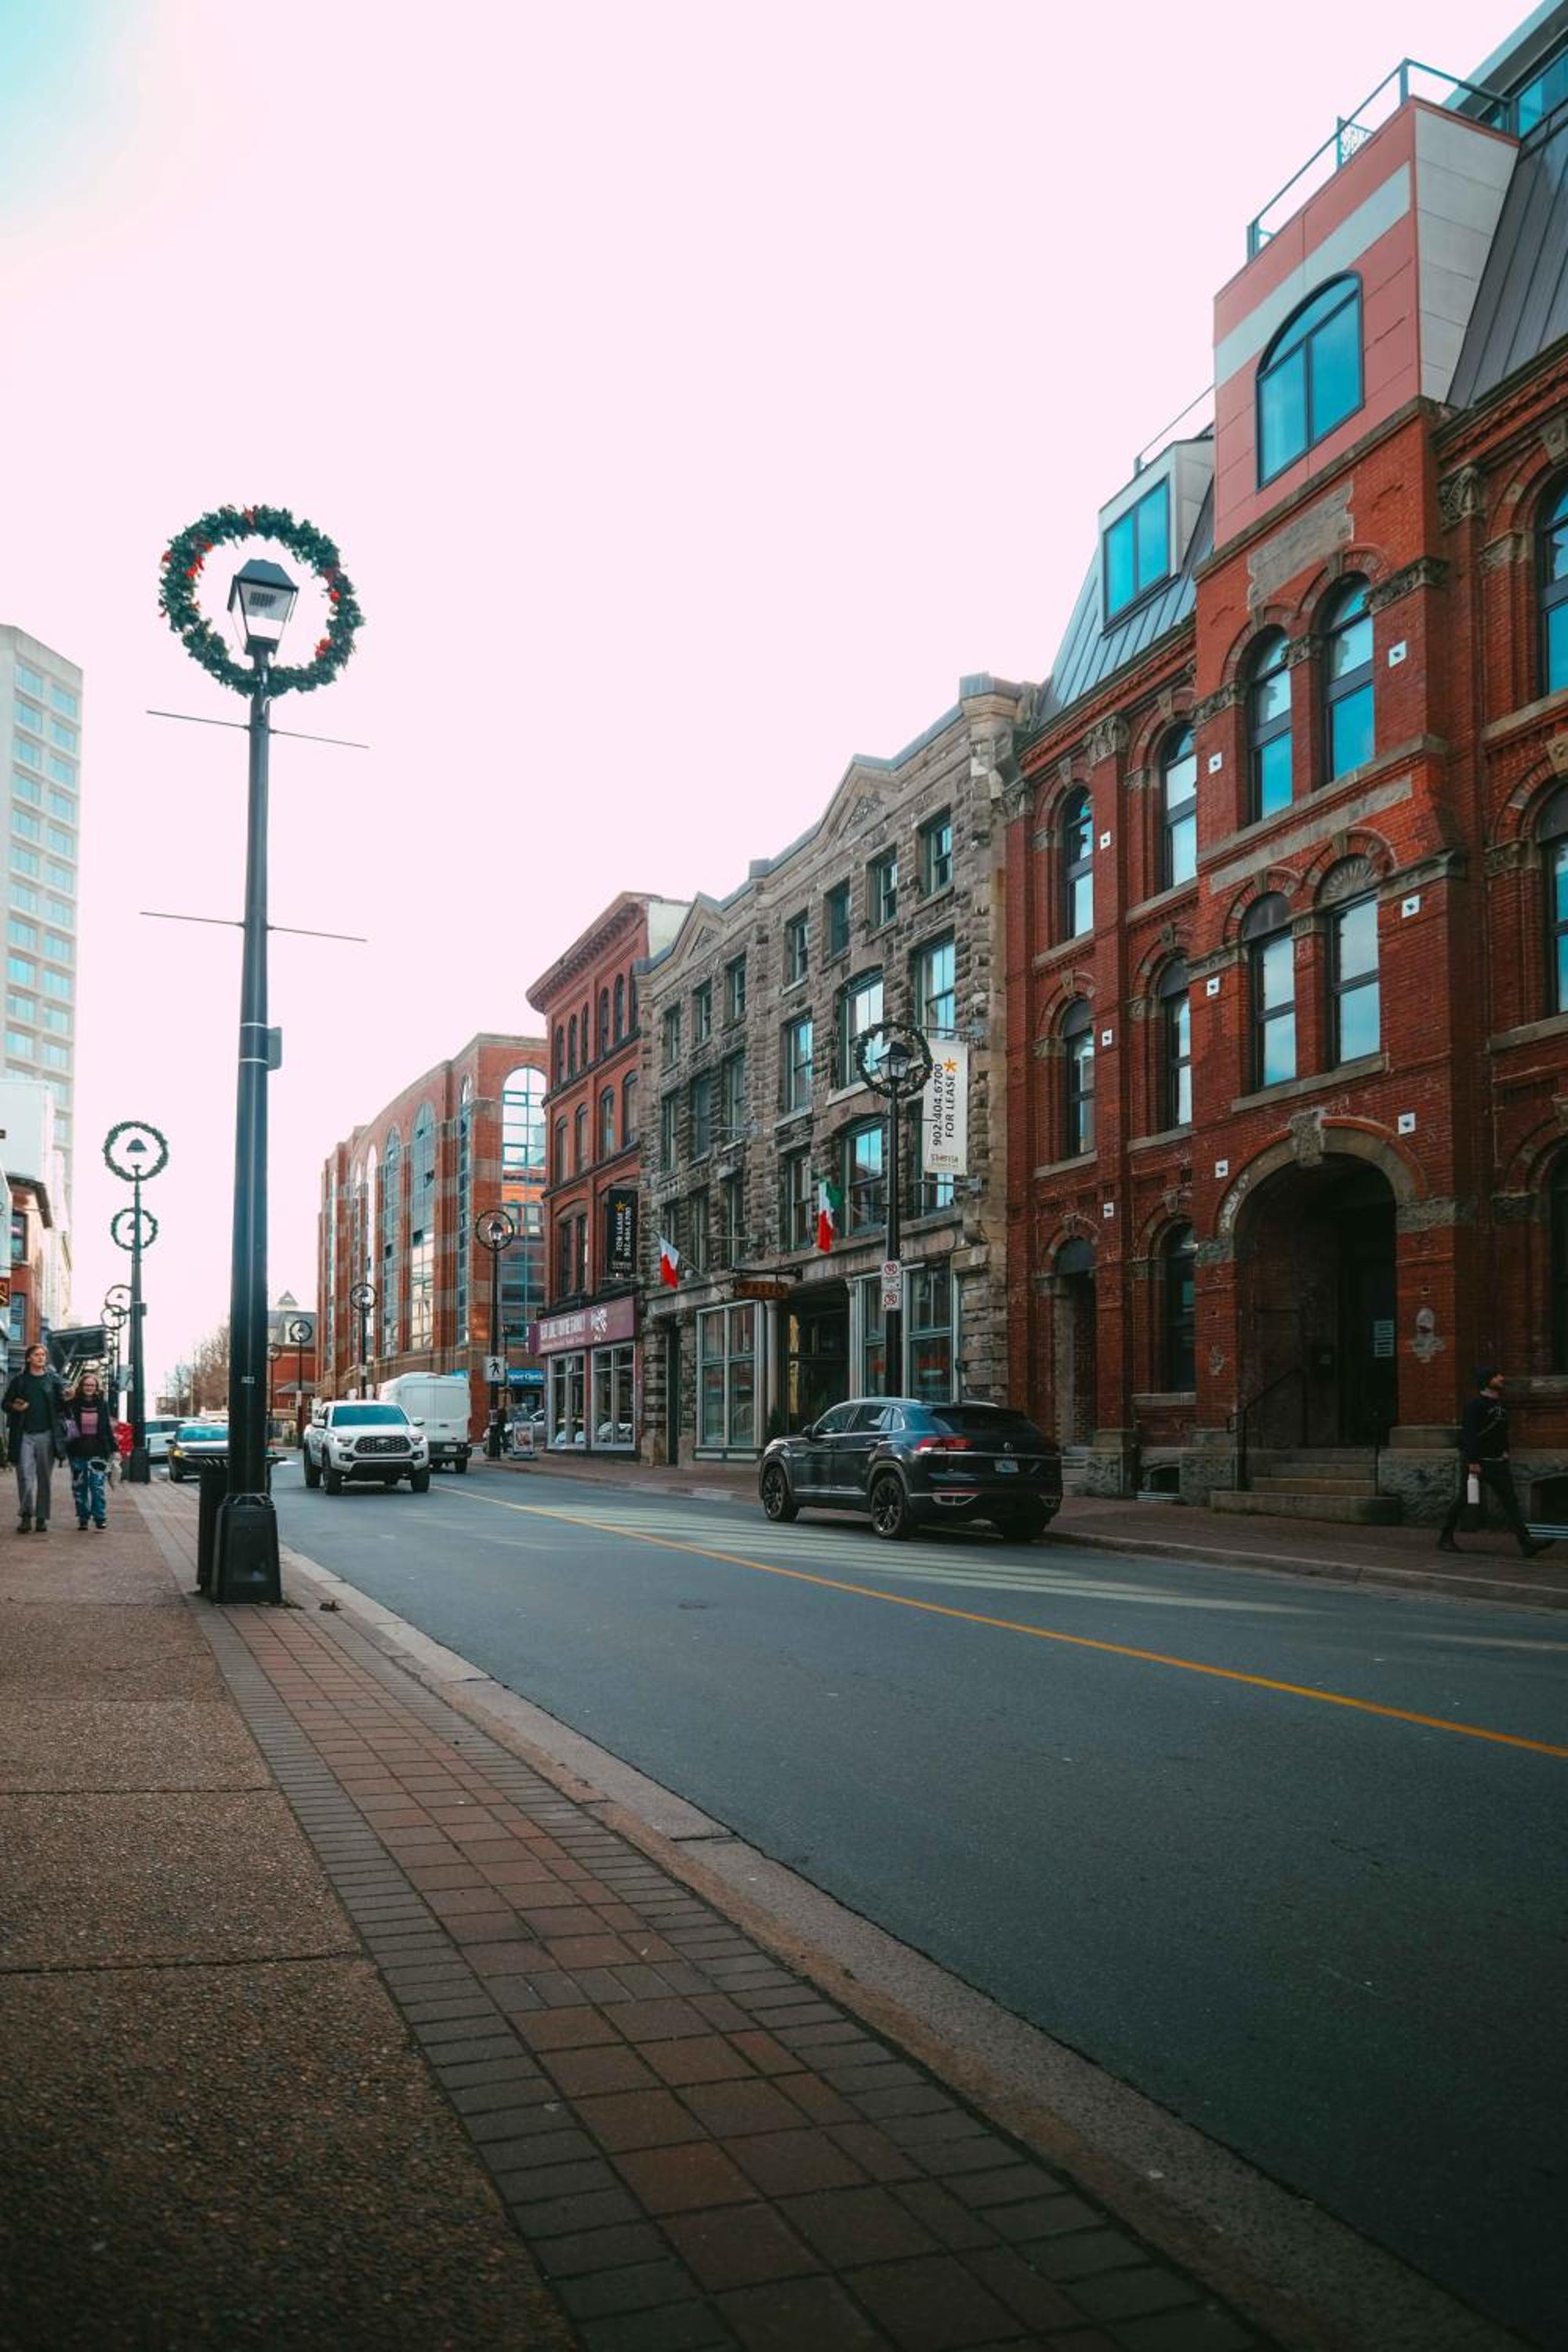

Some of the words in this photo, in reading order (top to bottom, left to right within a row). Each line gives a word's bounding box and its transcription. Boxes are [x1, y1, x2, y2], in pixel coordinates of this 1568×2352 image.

[932, 1063, 943, 1146] 902.404.6700
[945, 1074, 955, 1110] LEASE
[945, 1113, 954, 1138] FOR
